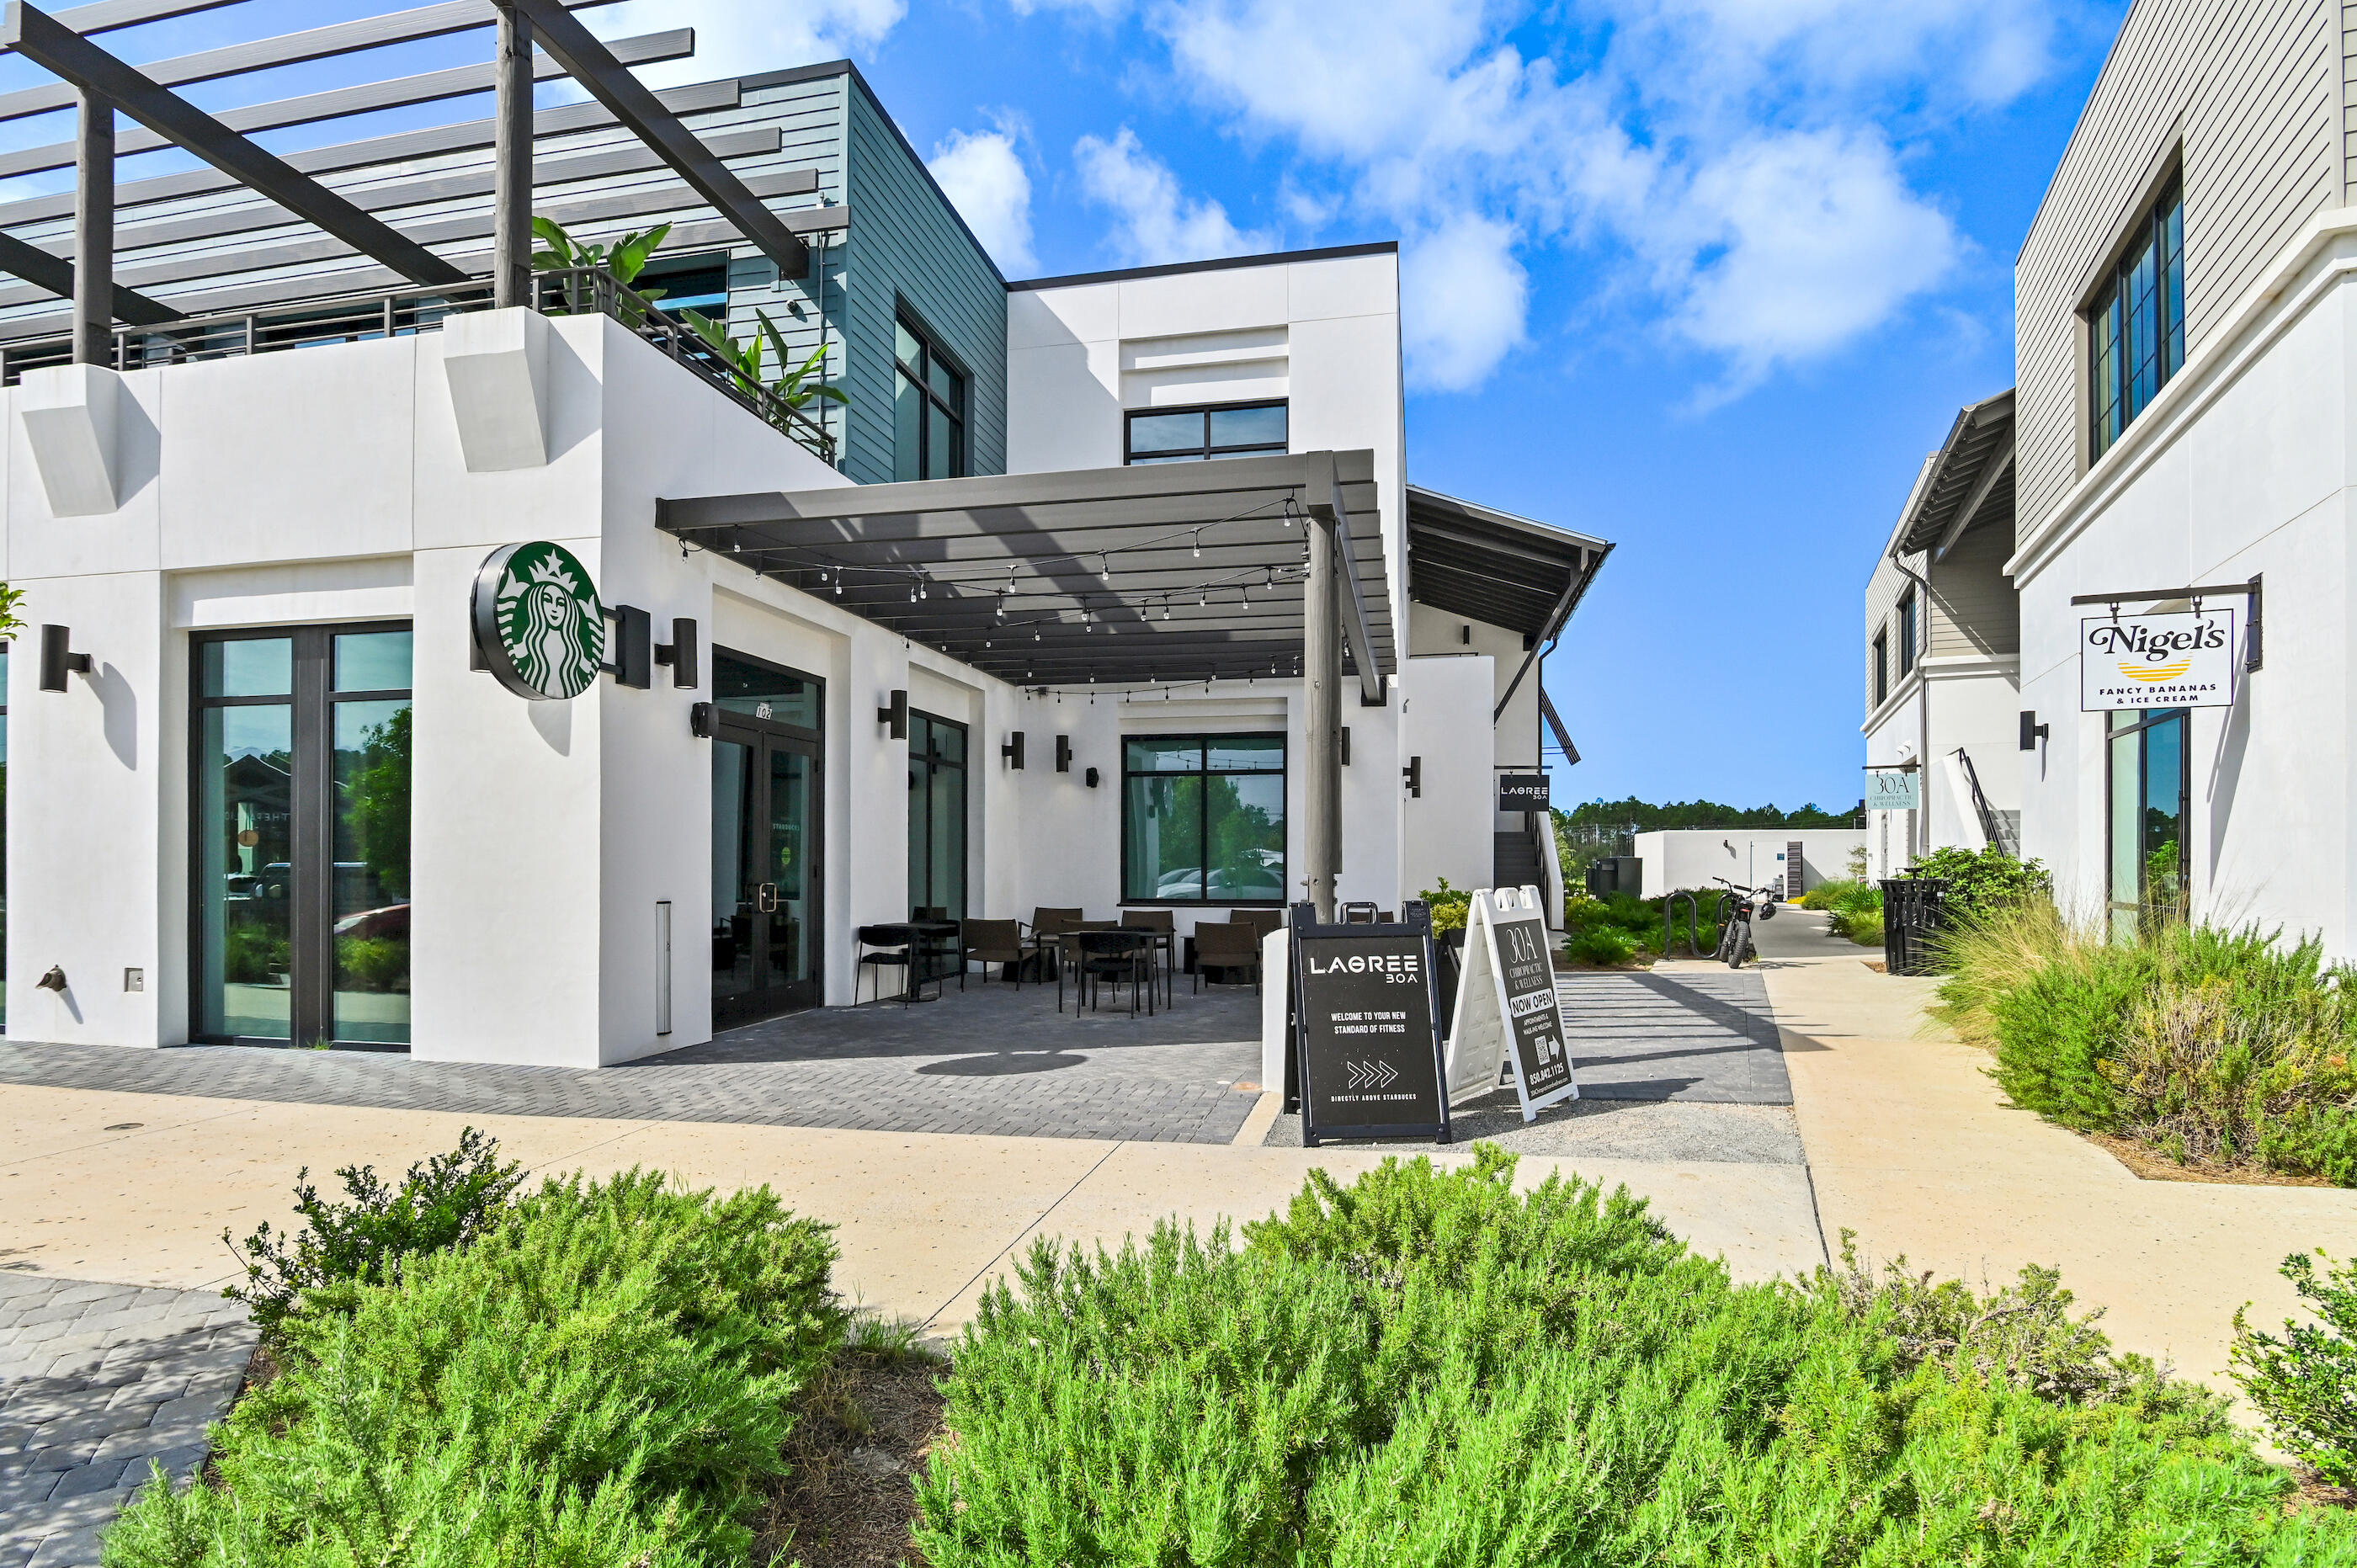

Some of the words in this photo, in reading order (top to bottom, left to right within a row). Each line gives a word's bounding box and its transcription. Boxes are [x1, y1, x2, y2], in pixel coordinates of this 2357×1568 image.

[2088, 619, 2226, 662] Nigel's
[2099, 687, 2142, 695] FANCY
[2149, 683, 2216, 694] BANANAS
[758, 707, 771, 719] 102
[1872, 777, 1909, 794] 30A
[1505, 926, 1538, 964] 30A
[1310, 955, 1418, 974] LAGREE
[1508, 962, 1543, 979] CHIROPRACTIC
[1385, 974, 1418, 983] 30A
[1519, 975, 1543, 989] WELLNESS
[1512, 997, 1531, 1014] NOW
[1533, 991, 1552, 1008] OPEN
[1331, 1013, 1362, 1022] WELCOME
[1374, 1012, 1391, 1020] YOUR
[1391, 1012, 1406, 1020] NEW
[1334, 1025, 1368, 1034] STANDARD
[1370, 1025, 1378, 1034] OF
[1379, 1024, 1405, 1033] FITNESS
[1529, 1062, 1564, 1086] 850.842.1125
